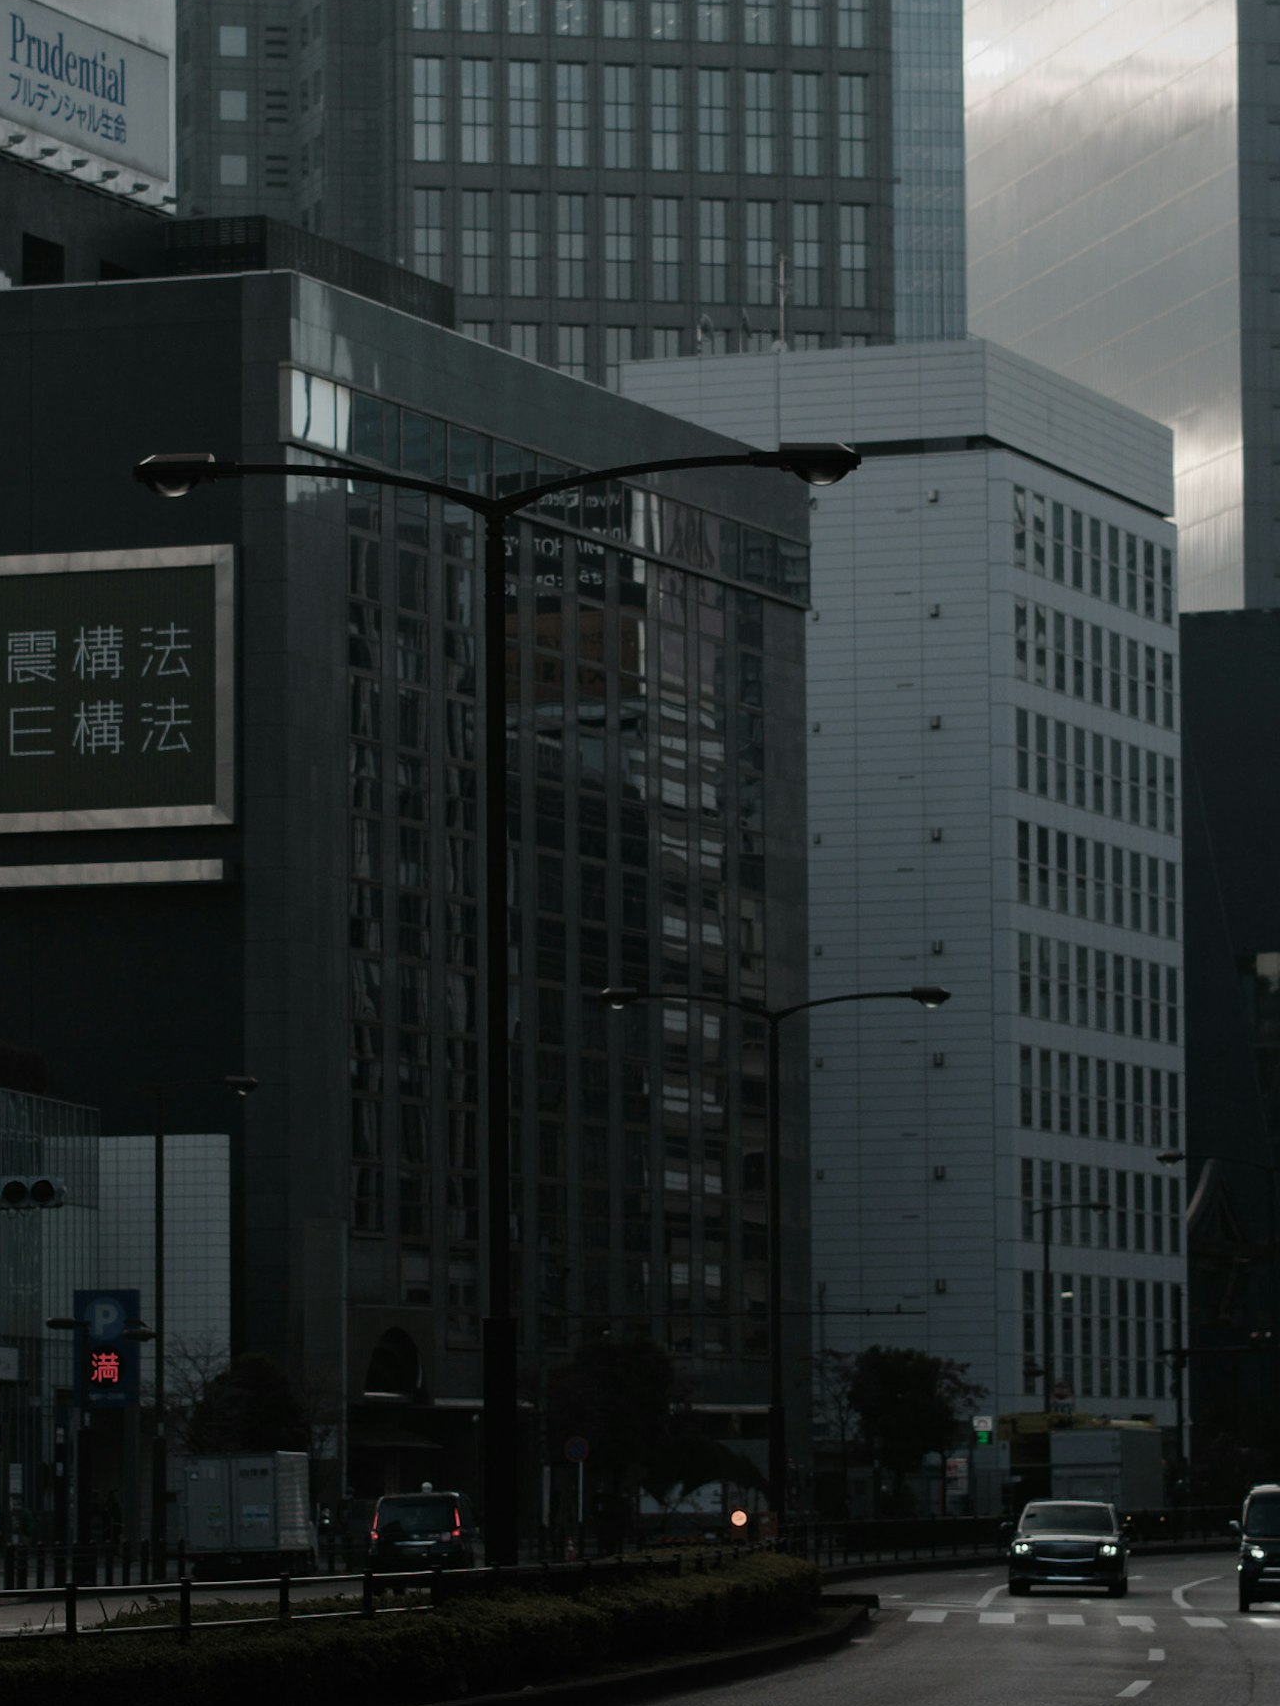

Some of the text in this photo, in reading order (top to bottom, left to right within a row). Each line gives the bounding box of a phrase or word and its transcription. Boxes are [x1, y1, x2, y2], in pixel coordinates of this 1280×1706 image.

[9, 12, 127, 107] Prudential
[9, 72, 127, 145] プルデンシャル生命
[95, 1303, 118, 1335] P
[90, 1351, 121, 1384] 満
